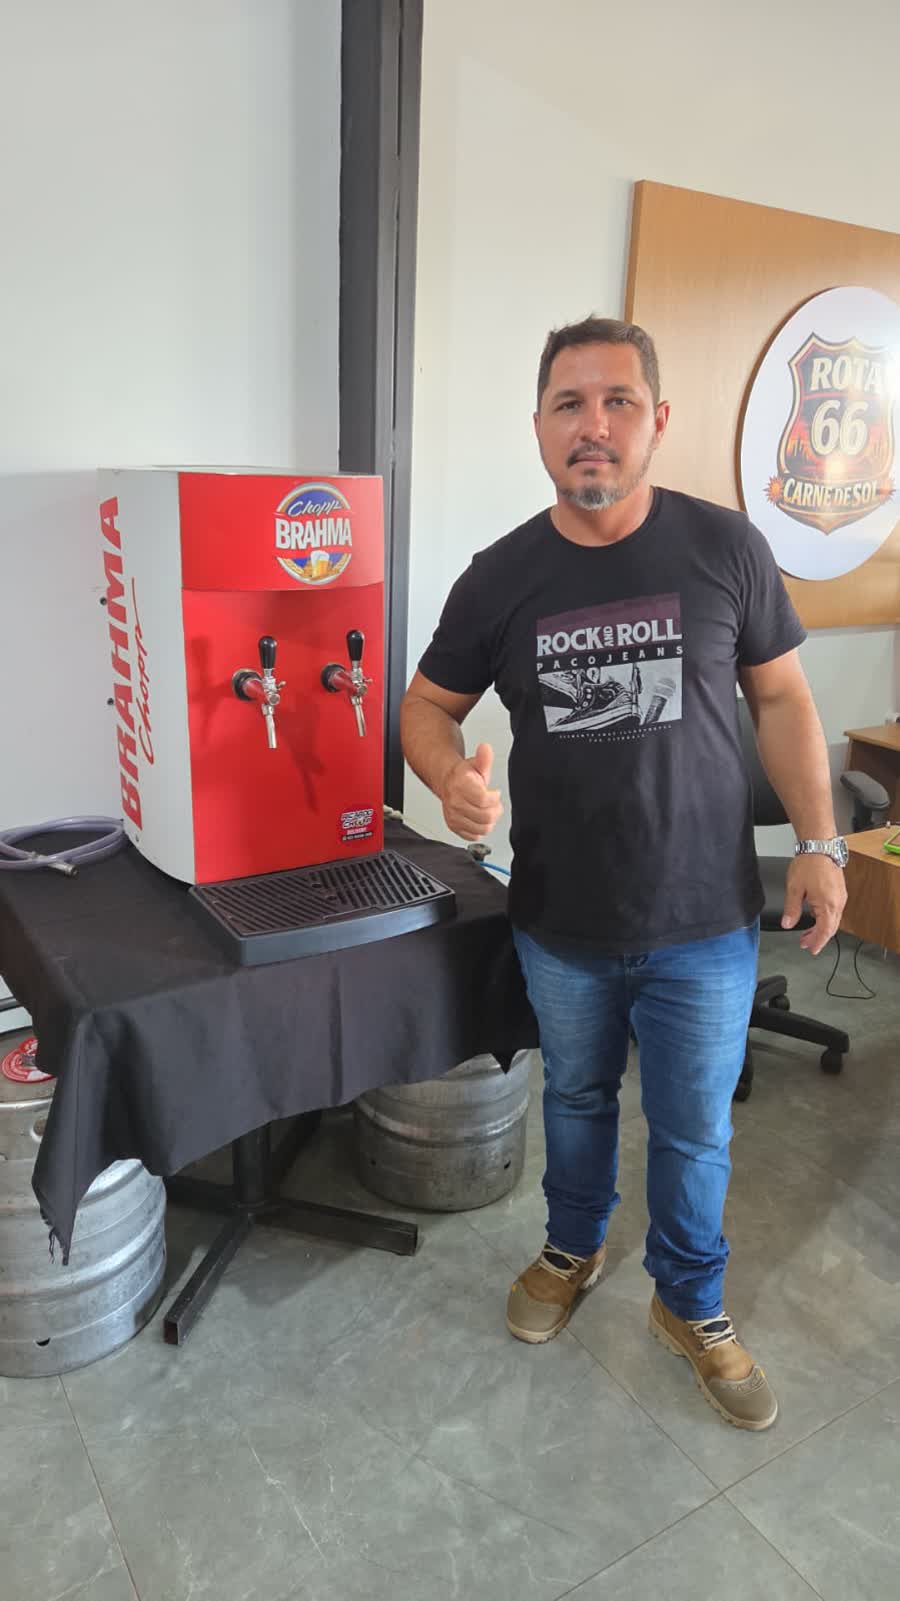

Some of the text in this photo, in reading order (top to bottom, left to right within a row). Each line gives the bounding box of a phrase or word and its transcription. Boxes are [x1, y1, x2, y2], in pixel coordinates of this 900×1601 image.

[810, 355, 882, 395] ROTA
[811, 399, 869, 456] 66
[783, 478, 879, 507] CARNE DE SOL
[275, 517, 353, 550] BRAHMA
[536, 618, 683, 657] ROCK AND ROLL
[100, 495, 143, 832] BRAHMA
